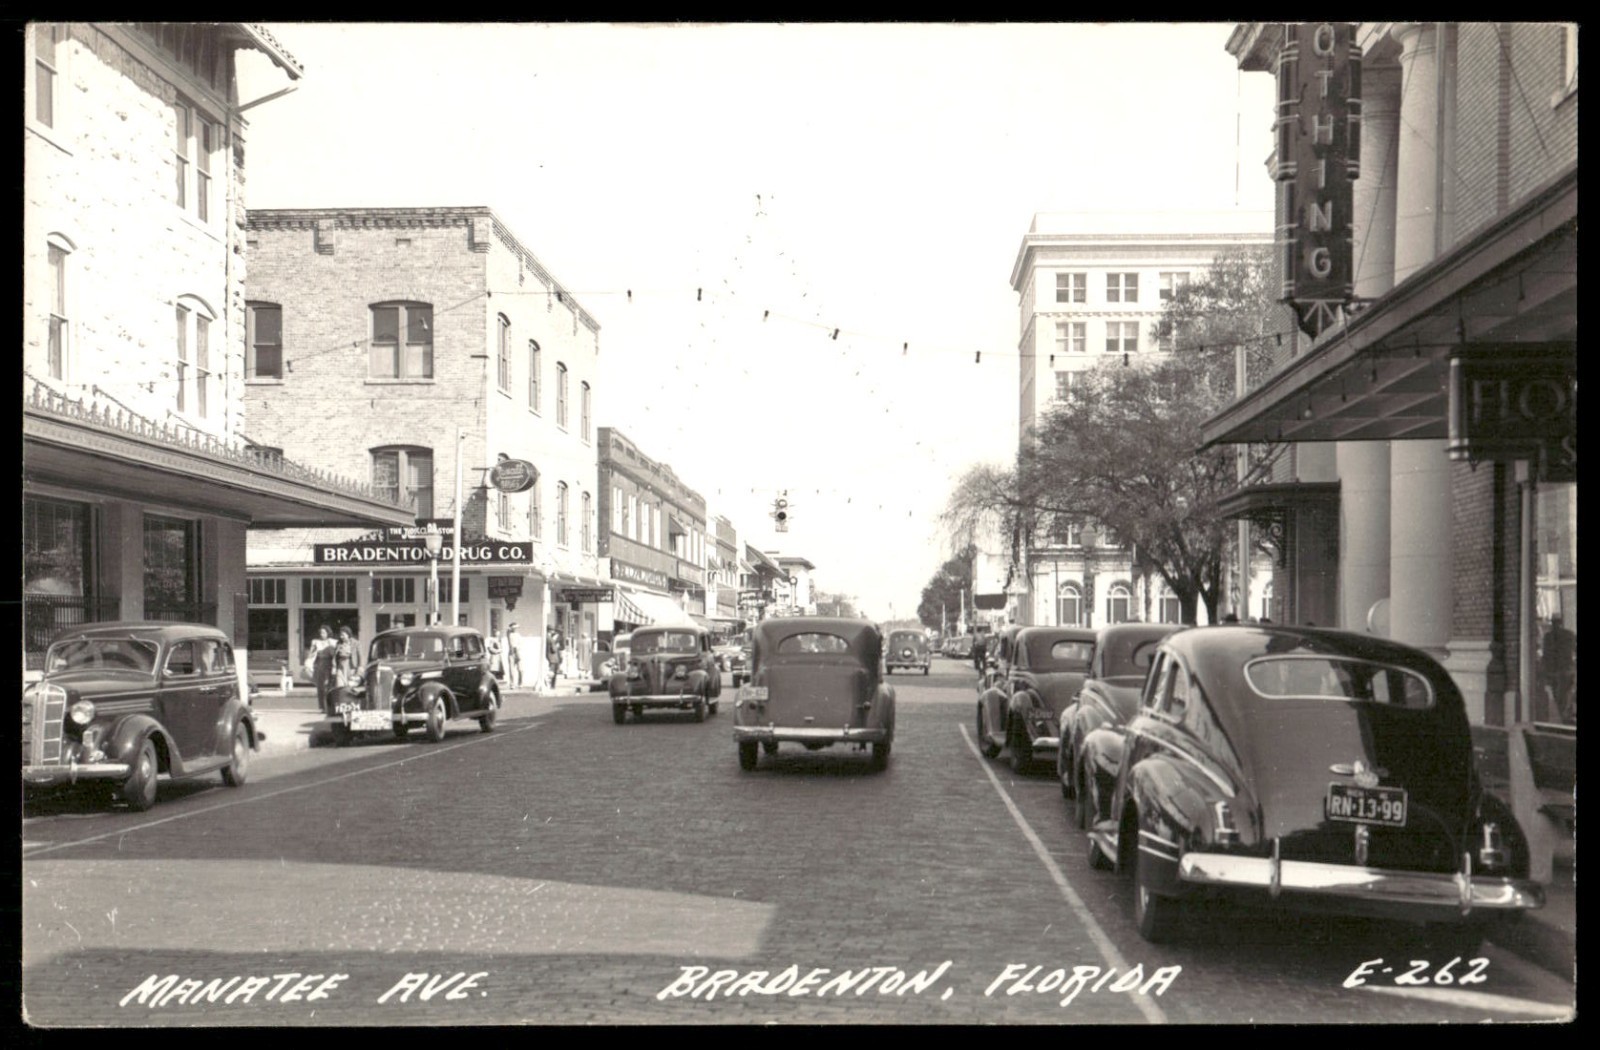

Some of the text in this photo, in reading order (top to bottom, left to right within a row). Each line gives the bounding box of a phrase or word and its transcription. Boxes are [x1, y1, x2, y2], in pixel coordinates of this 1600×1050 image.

[323, 546, 526, 561] BRADENTON DRUG CO.
